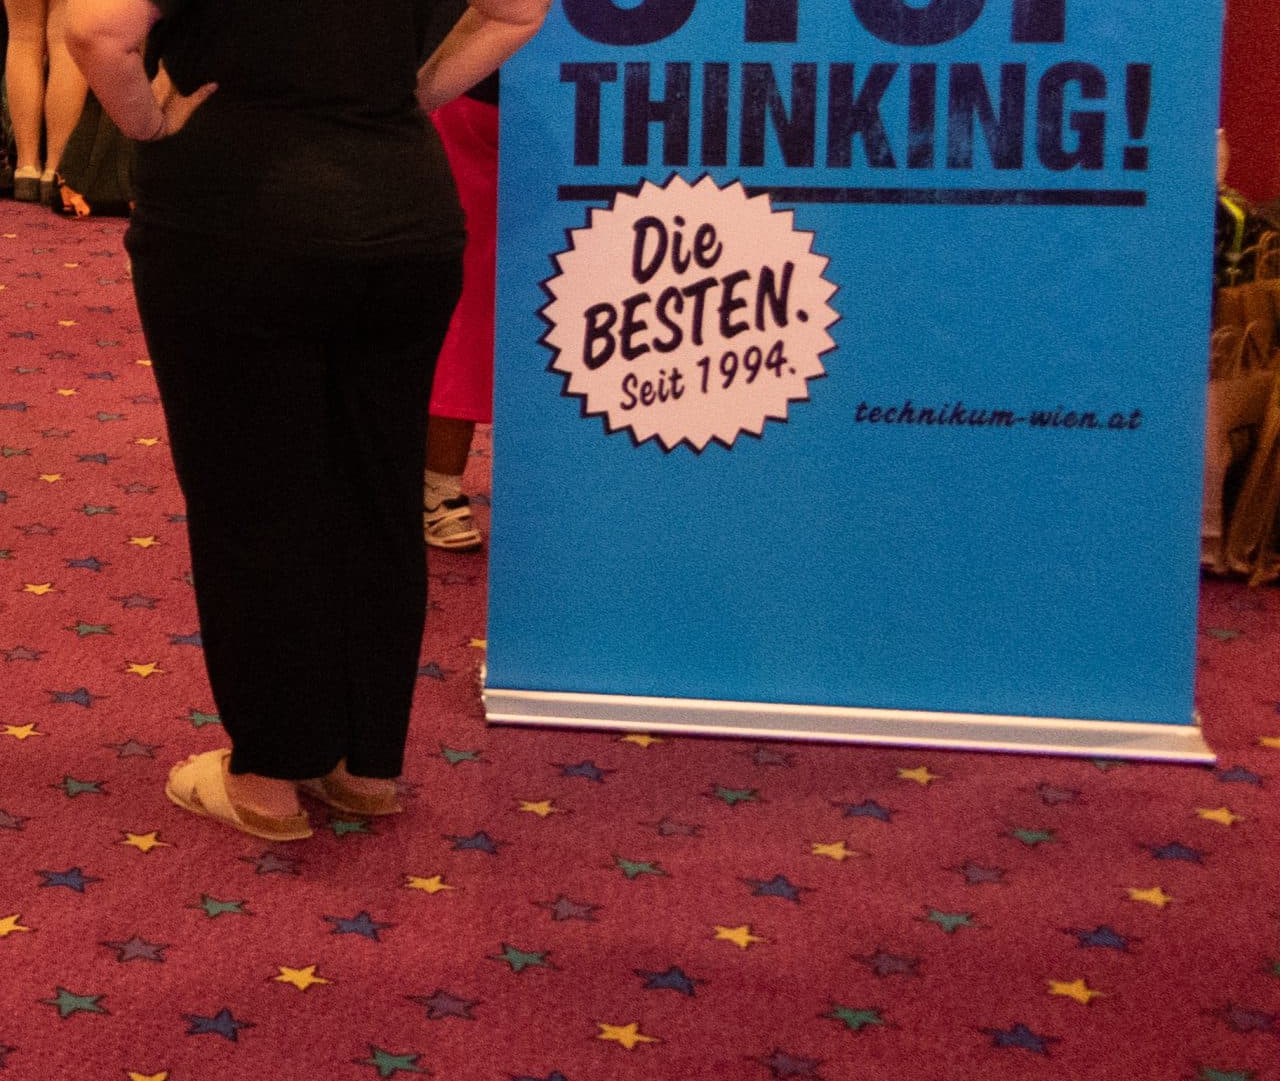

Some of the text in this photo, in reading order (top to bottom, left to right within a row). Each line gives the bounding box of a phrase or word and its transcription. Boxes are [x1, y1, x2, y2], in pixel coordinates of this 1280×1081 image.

[559, 61, 1154, 170] THINKING!
[632, 215, 723, 284] Die
[582, 260, 809, 371] BESTEN.
[620, 339, 796, 411] Seit 1994.
[854, 399, 1142, 431] technikum-wien.at
